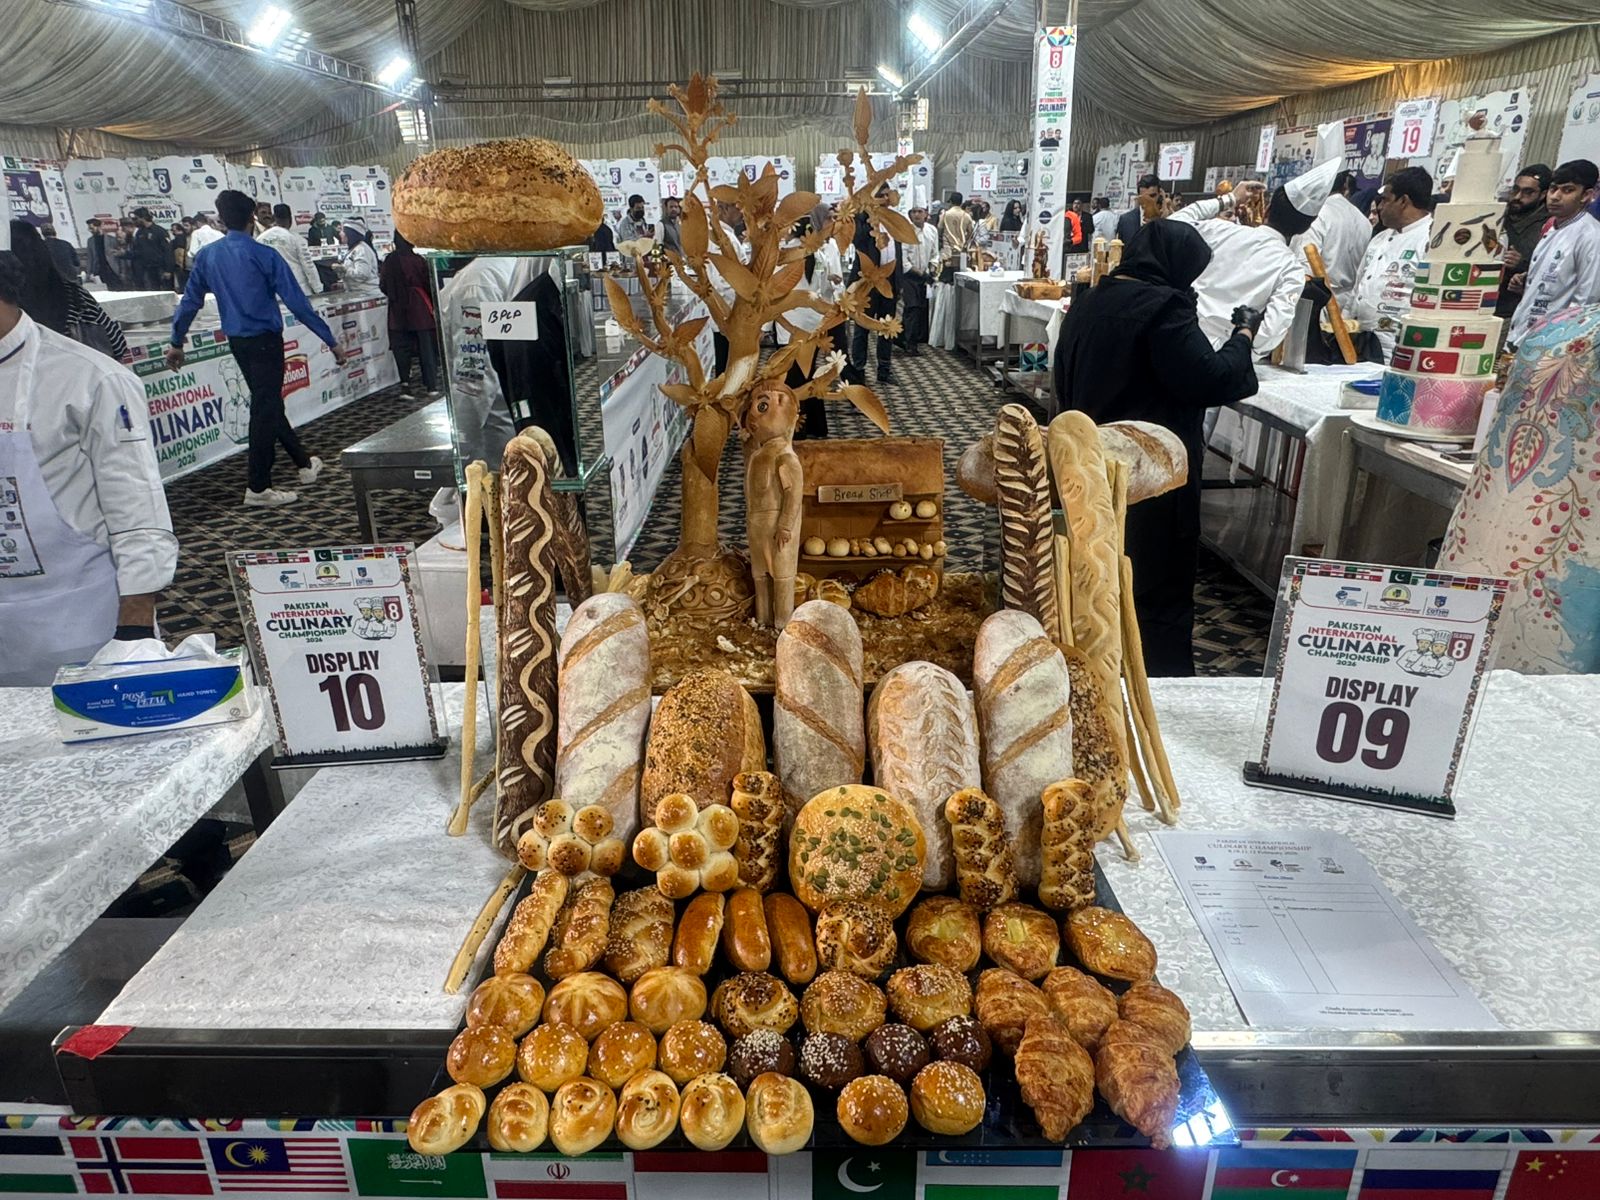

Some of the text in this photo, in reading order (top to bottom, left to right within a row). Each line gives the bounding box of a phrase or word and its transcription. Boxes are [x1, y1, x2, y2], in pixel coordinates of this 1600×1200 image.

[1052, 51, 1061, 68] 8
[1039, 104, 1067, 112] CULINARY
[1402, 127, 1421, 154] 19
[1168, 160, 1183, 177] 17
[158, 174, 167, 190] 8
[612, 171, 619, 184] 8
[980, 176, 991, 189] 15
[667, 183, 678, 197] 13
[823, 180, 834, 192] 14
[358, 193, 369, 204] 11
[501, 323, 513, 334] 10
[144, 372, 196, 399] PAKISTAN
[177, 453, 197, 469] 2026
[834, 488, 863, 501] Bread
[270, 608, 346, 619] INTERNATIONAL
[284, 601, 329, 610] PAKISTAN
[388, 602, 400, 620] 8
[266, 615, 354, 632] CULINARY
[1327, 620, 1382, 633] PAKISTAN
[278, 628, 347, 639] CHAMPIONSHIP
[1308, 626, 1398, 643] INTERNATIONAL
[1297, 634, 1406, 658] CULINARY
[1452, 639, 1467, 659] 8
[305, 650, 380, 674] DISPLAY
[1307, 648, 1390, 664] CHAMPIONSHIP
[1336, 659, 1357, 667] 2026
[1325, 676, 1419, 708] DISPLAY
[318, 672, 386, 732] 10
[1315, 701, 1411, 770] 09
